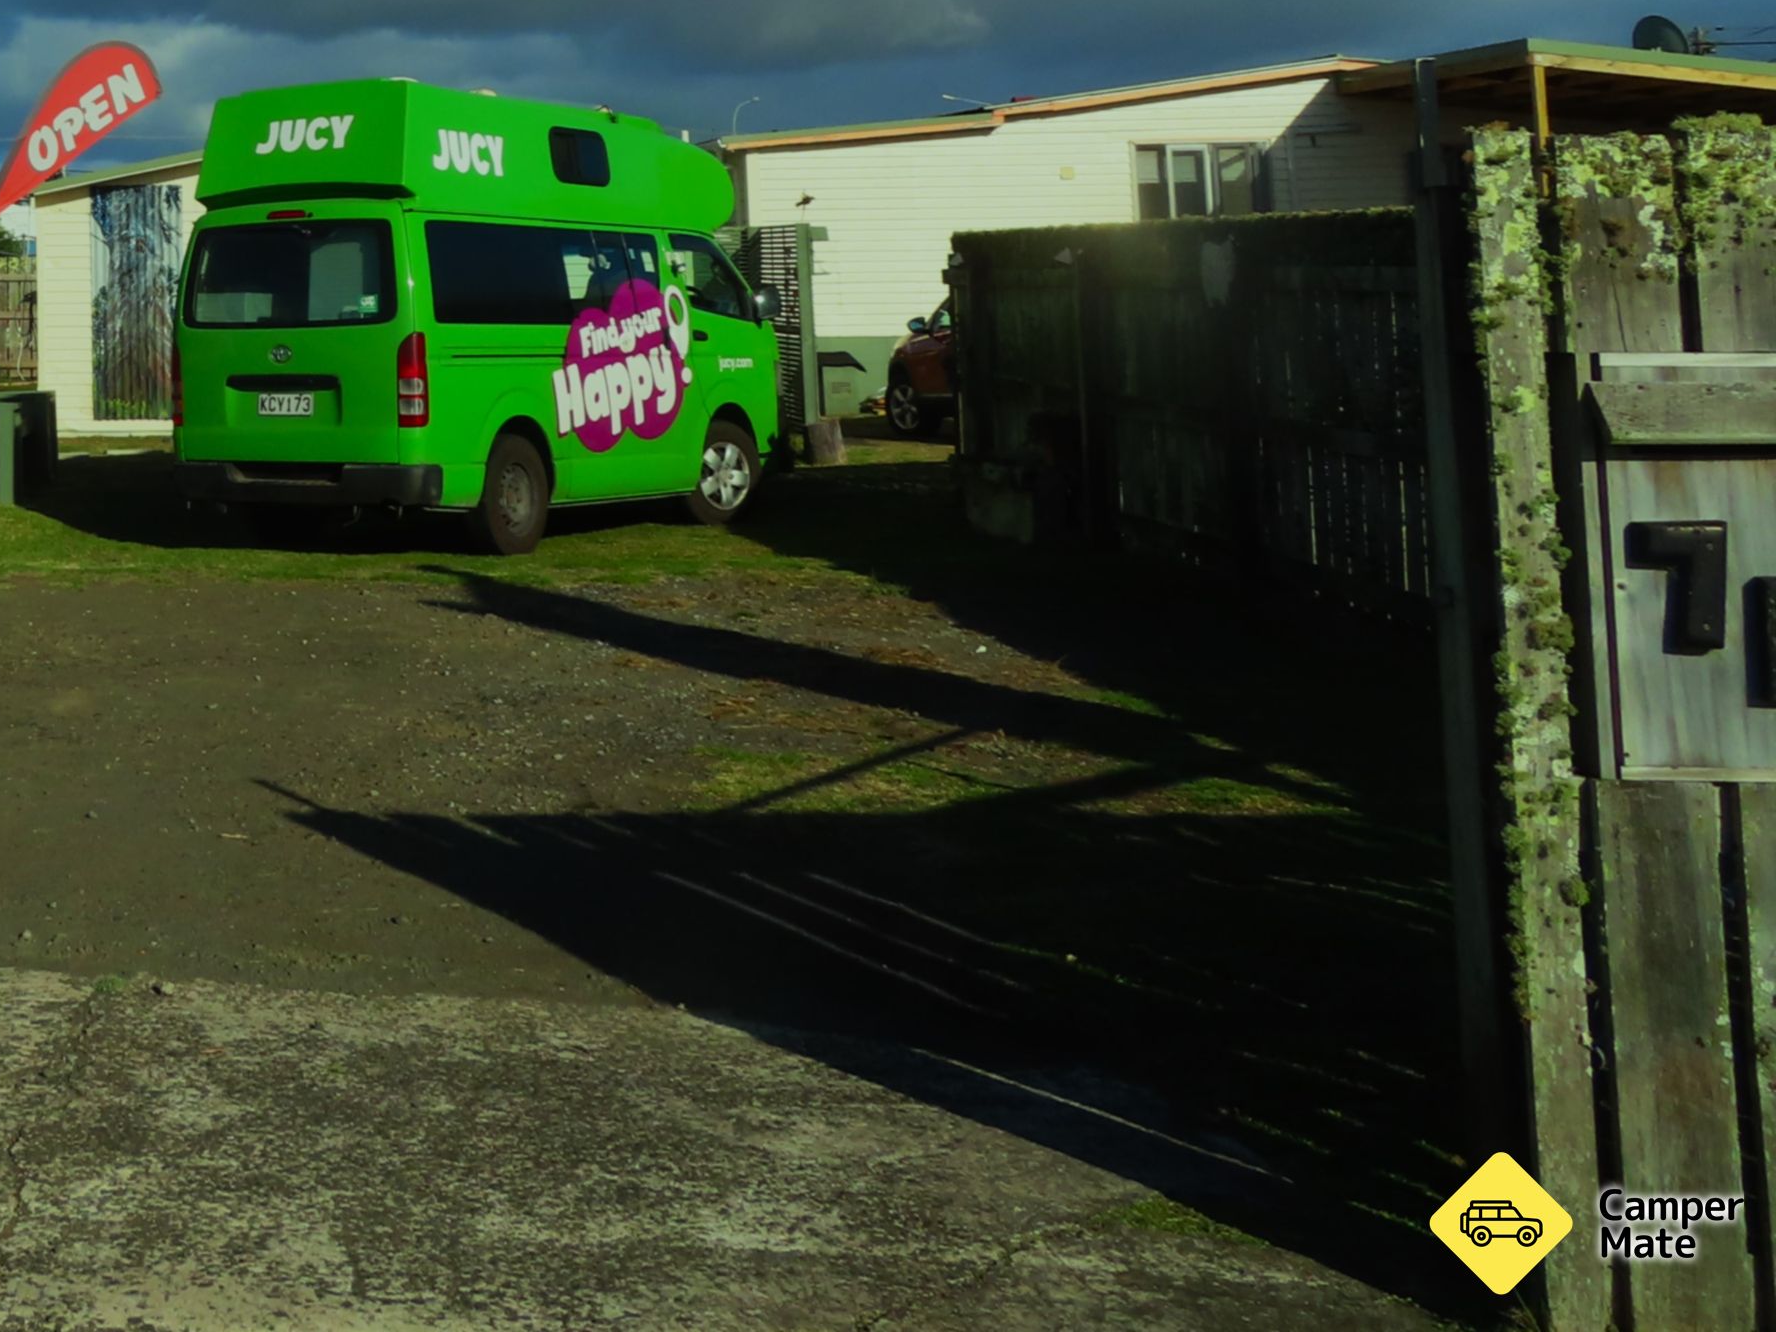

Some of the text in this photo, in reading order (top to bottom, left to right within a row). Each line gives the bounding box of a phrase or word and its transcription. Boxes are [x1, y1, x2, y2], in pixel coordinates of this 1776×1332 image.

[27, 63, 146, 172] OPEN
[255, 115, 354, 154] JUCY
[432, 129, 504, 177] JUCY
[579, 307, 662, 359] Find your
[717, 354, 754, 373] jucy.com
[260, 396, 311, 413] KCY173
